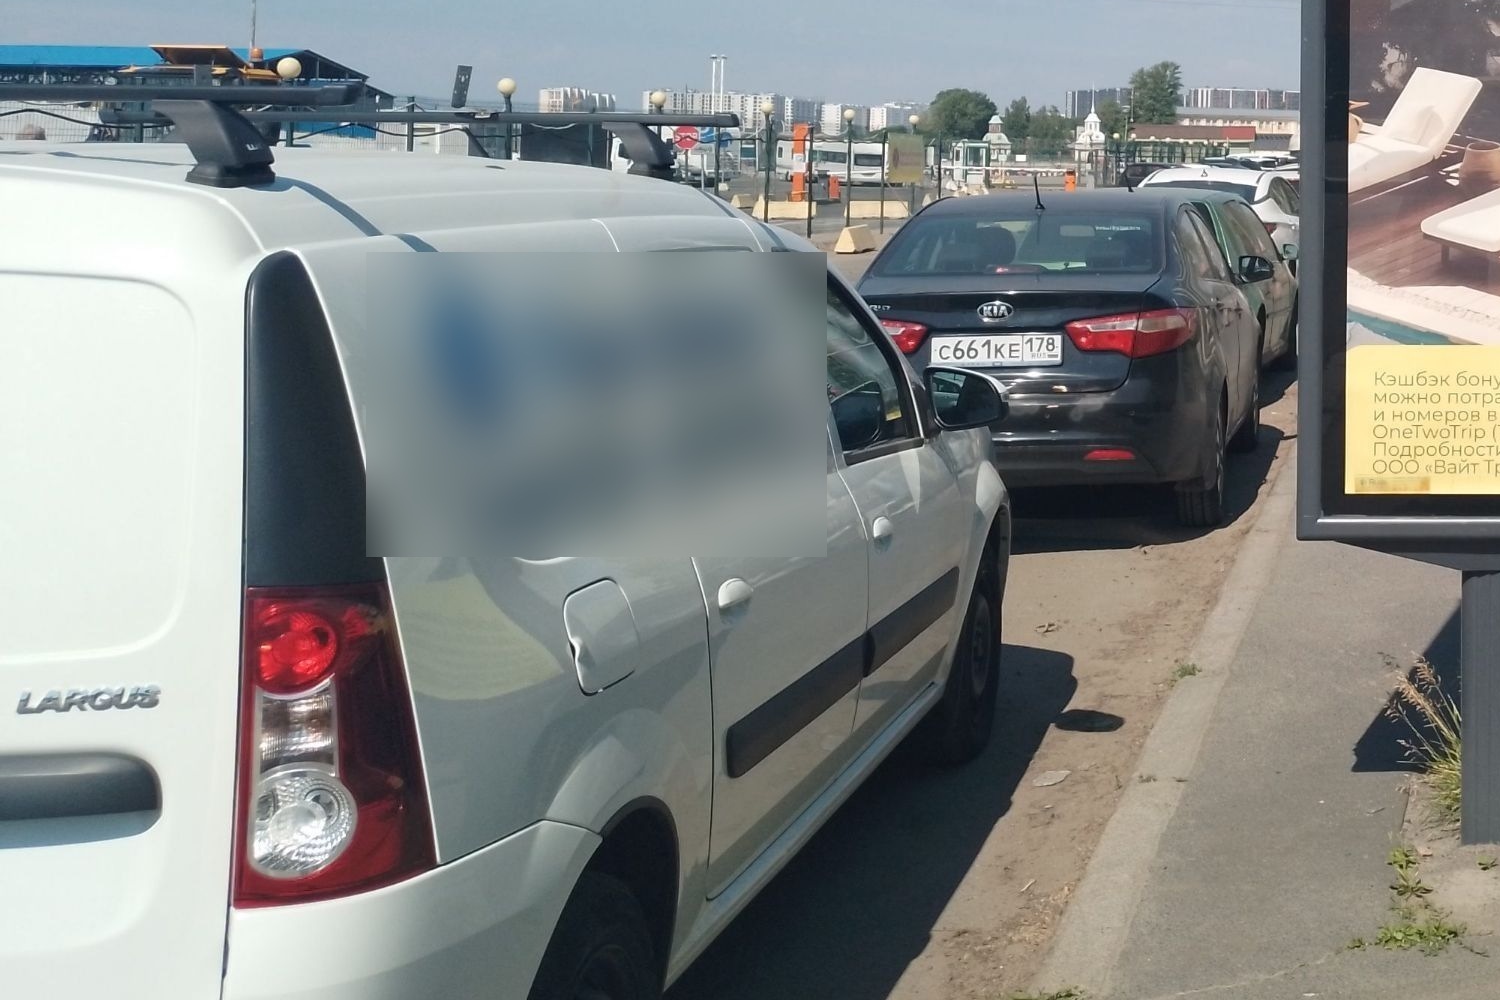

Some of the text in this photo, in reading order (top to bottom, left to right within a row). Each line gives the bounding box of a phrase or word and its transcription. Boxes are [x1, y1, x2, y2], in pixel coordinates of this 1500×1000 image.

[983, 305, 1008, 317] KIA
[1024, 336, 1056, 353] 178
[1374, 370, 1450, 387] Кэшбэк
[1374, 391, 1443, 404] можно
[1374, 409, 1384, 423] и
[1391, 409, 1480, 426] номеров
[1488, 409, 1498, 422] в
[1373, 423, 1487, 441] OneTwoTrip
[1372, 459, 1421, 475] ООО
[1425, 458, 1480, 475] «Вайт
[17, 684, 161, 714] LARGUS
